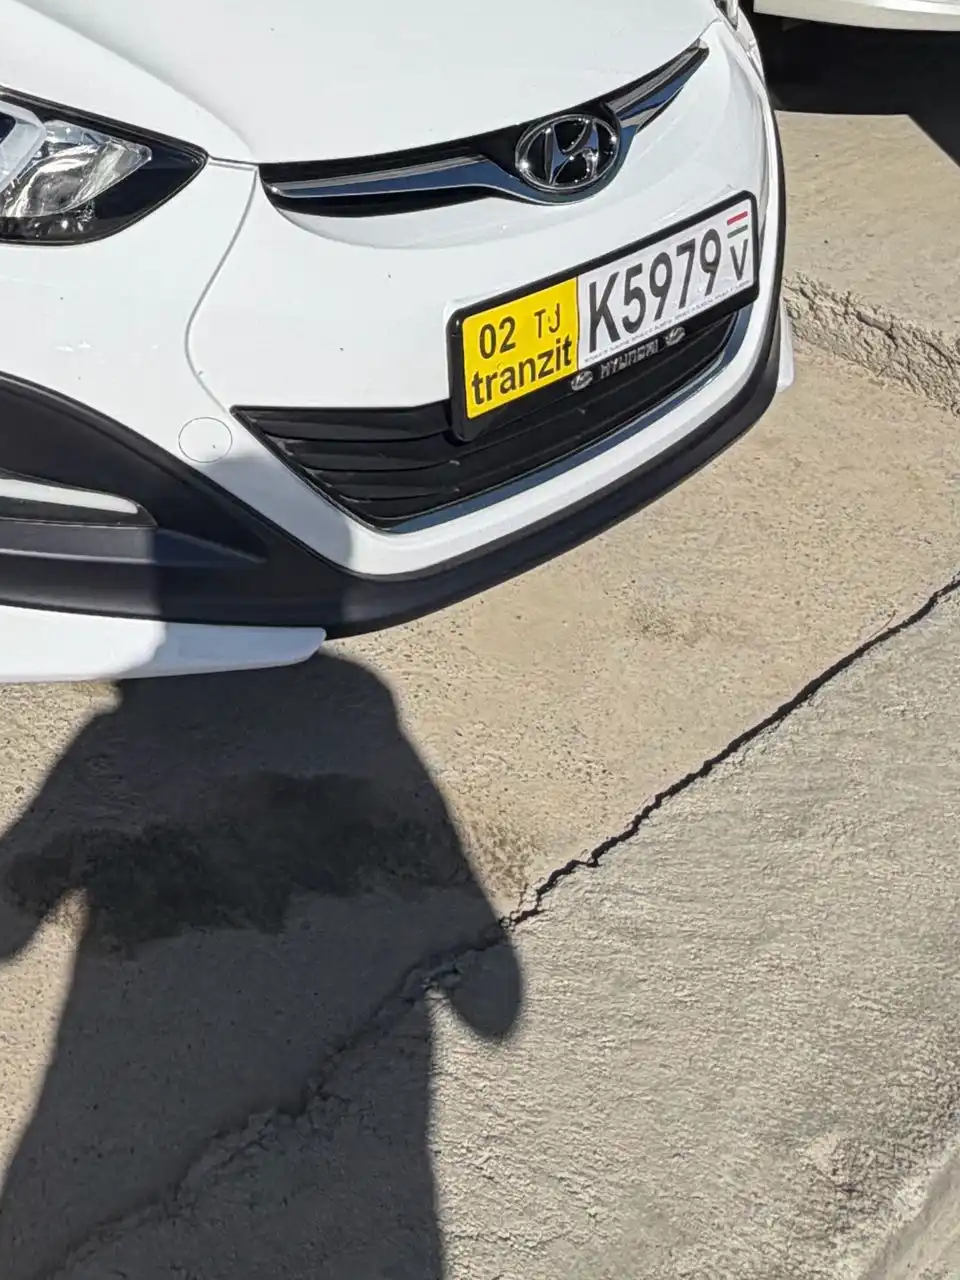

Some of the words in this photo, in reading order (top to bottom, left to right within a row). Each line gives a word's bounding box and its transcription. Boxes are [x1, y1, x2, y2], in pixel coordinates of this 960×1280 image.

[588, 228, 722, 354] K5979
[730, 239, 749, 281] V
[478, 315, 516, 360] 02
[534, 303, 561, 339] TJ
[471, 335, 573, 406] tranzit
